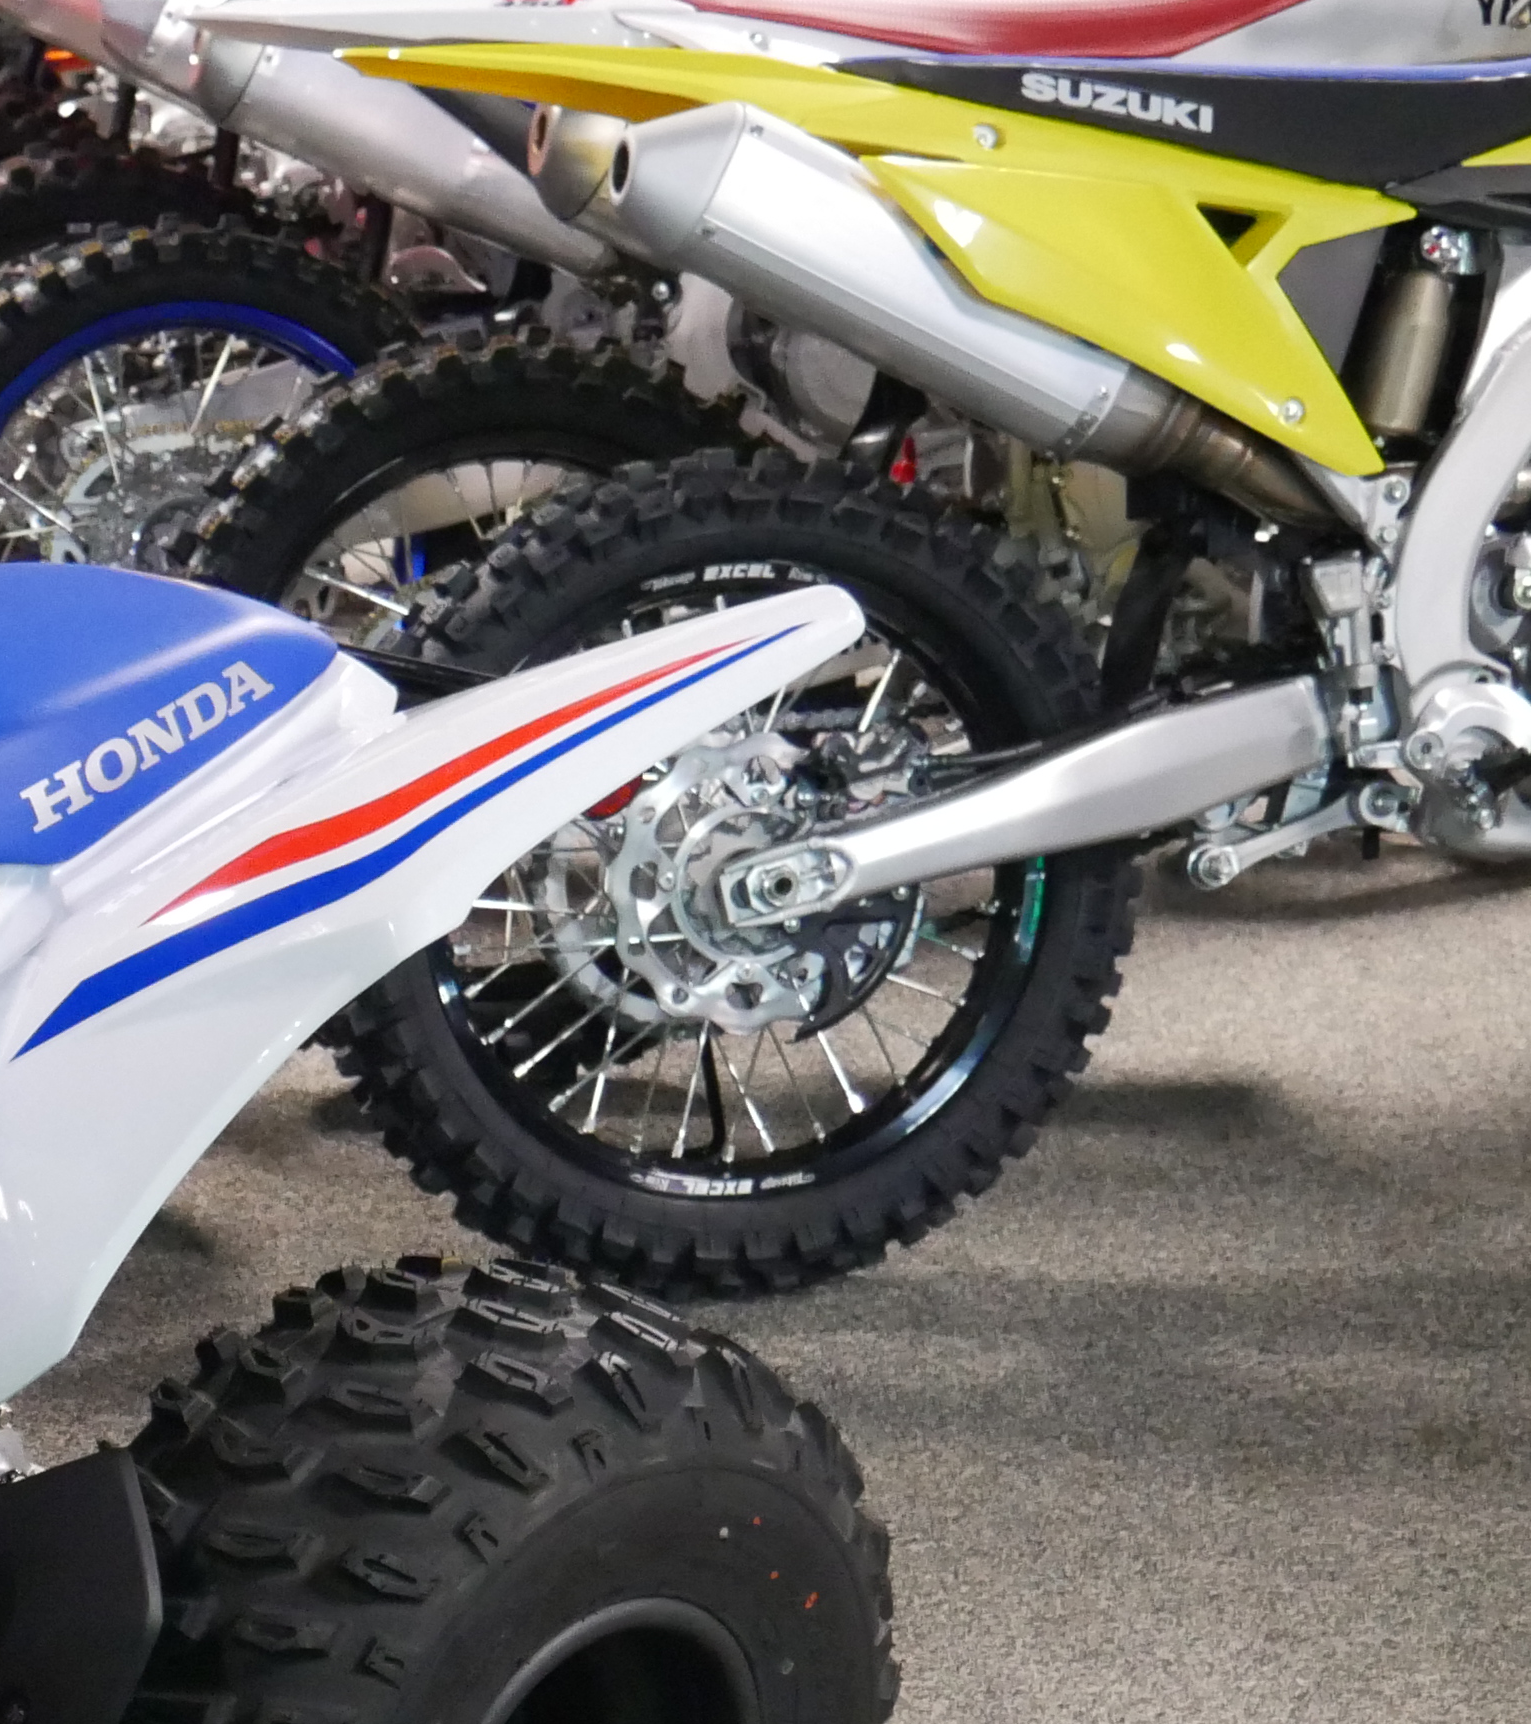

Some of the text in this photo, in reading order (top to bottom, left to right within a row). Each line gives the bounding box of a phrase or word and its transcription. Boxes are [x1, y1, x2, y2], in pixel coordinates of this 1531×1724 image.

[1021, 71, 1214, 134] SUZUKI
[703, 563, 776, 582] EXCEL
[19, 660, 275, 833] HONDA
